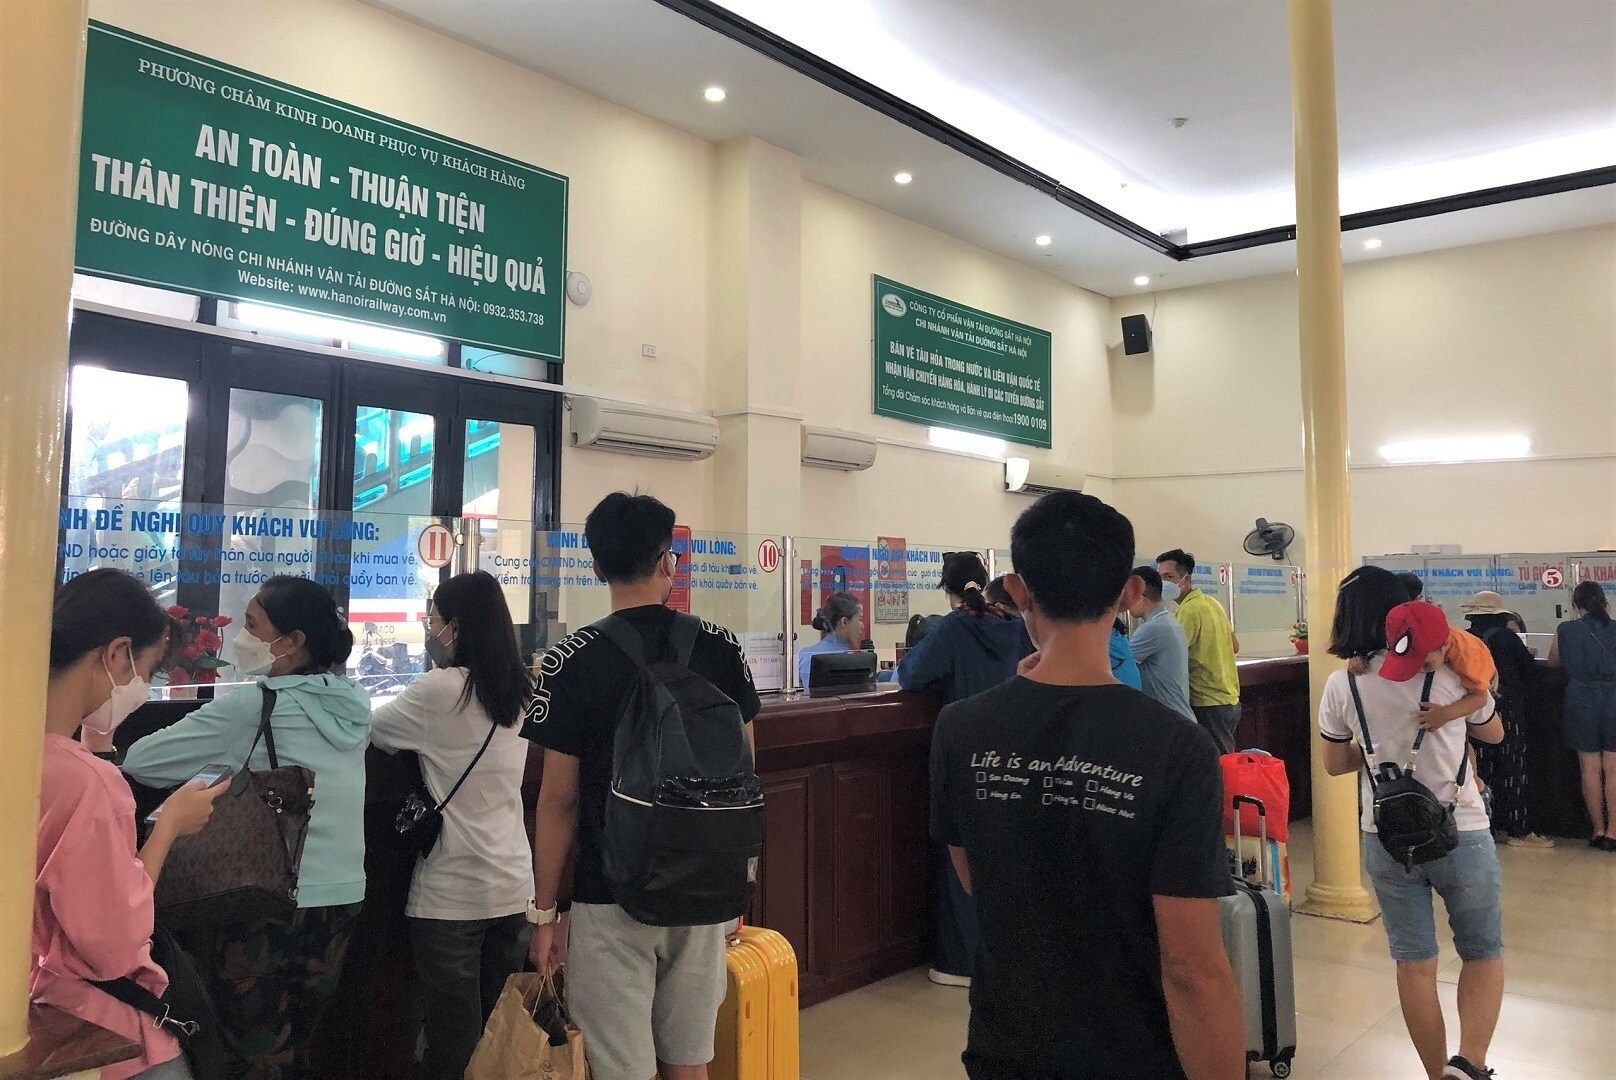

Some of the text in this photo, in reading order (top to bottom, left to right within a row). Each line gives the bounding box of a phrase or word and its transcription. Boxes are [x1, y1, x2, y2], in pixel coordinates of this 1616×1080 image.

[138, 58, 526, 191] PHƯƠNG CHÂM KINH DOANH PHỤC VỤ KHÁCH HÀNG
[195, 123, 240, 168] AN
[249, 137, 322, 190] TOÀN
[348, 166, 429, 220] THUẬN
[435, 191, 486, 236] TIỆN
[91, 153, 181, 210] THÂN
[190, 178, 277, 234] THIỆN
[304, 207, 377, 256] ĐÚNG
[384, 227, 426, 267] GIỜ
[447, 243, 498, 287] HIỆU
[504, 256, 546, 295] QUẢ
[90, 217, 545, 326] ĐƯỜNG DÂY NÓNG CHI NHÁNH VẬN TẢI ĐƯỜNG SẮT HÀ NỘI: 0932.353.738
[237, 269, 447, 323] Website: www.hanoirailway.com.vn
[909, 300, 928, 314] CÔNG
[928, 306, 936, 317] TY
[936, 307, 946, 320] CỔ
[963, 317, 975, 330] VẬN
[984, 324, 1004, 338] ĐƯỜNG
[1004, 329, 1015, 340] SẮT
[1015, 332, 1023, 343] HÀ
[1022, 335, 1032, 347] NỘI
[915, 317, 927, 329] CHI
[927, 321, 950, 336] NHÁNH
[950, 327, 964, 341] VẬN
[1008, 344, 1017, 355] HÀ
[1017, 347, 1028, 359] NỘI
[885, 360, 902, 379] NHẬN
[902, 364, 915, 382] VẬN
[937, 373, 953, 390] HÀNG
[966, 381, 981, 397] HÀNH
[981, 384, 988, 398] LÝ
[993, 387, 1004, 402] CÁC
[889, 340, 905, 357] BÁN
[905, 344, 915, 360] VÉ
[915, 347, 929, 364] TÀU
[944, 356, 965, 373] TRONG
[965, 362, 983, 378] NƯỚC
[983, 365, 992, 380] VÀ
[992, 368, 1006, 383] LIÊN
[1006, 371, 1018, 388] VẬN
[1018, 374, 1033, 390] QUỐC
[1033, 377, 1041, 392] TẾ
[882, 383, 896, 400] Tổng
[921, 395, 931, 406] sóc
[931, 395, 947, 410] khách
[947, 400, 960, 415] hàng
[960, 403, 967, 414] và
[982, 410, 992, 420] qua
[1030, 416, 1047, 431] 0109
[60, 507, 88, 530] NH
[95, 503, 124, 531] ĐỀ
[130, 510, 180, 537] NGHỊ
[232, 512, 293, 538] KHÁCH
[299, 518, 326, 539] VUI
[331, 519, 379, 541] LÒNG:
[88, 543, 129, 562] hoặc
[134, 542, 167, 563] giấy
[249, 546, 274, 562] của
[277, 549, 313, 566] người
[353, 552, 370, 564] khi
[373, 554, 398, 564] mua
[427, 531, 448, 561] 11
[494, 555, 520, 570] Cung
[691, 539, 706, 554] VUI
[709, 537, 737, 556] LÒNG:
[762, 544, 778, 568] 10
[906, 548, 928, 562] KHÁCH
[929, 551, 940, 563] VUI
[150, 568, 172, 583] lên
[563, 575, 574, 586] tin
[576, 574, 593, 586] trên
[1546, 570, 1560, 585] 5
[970, 750, 1001, 768] Life
[1006, 752, 1022, 769] is
[1027, 759, 1052, 772] an
[1053, 755, 1143, 787] Adventure
